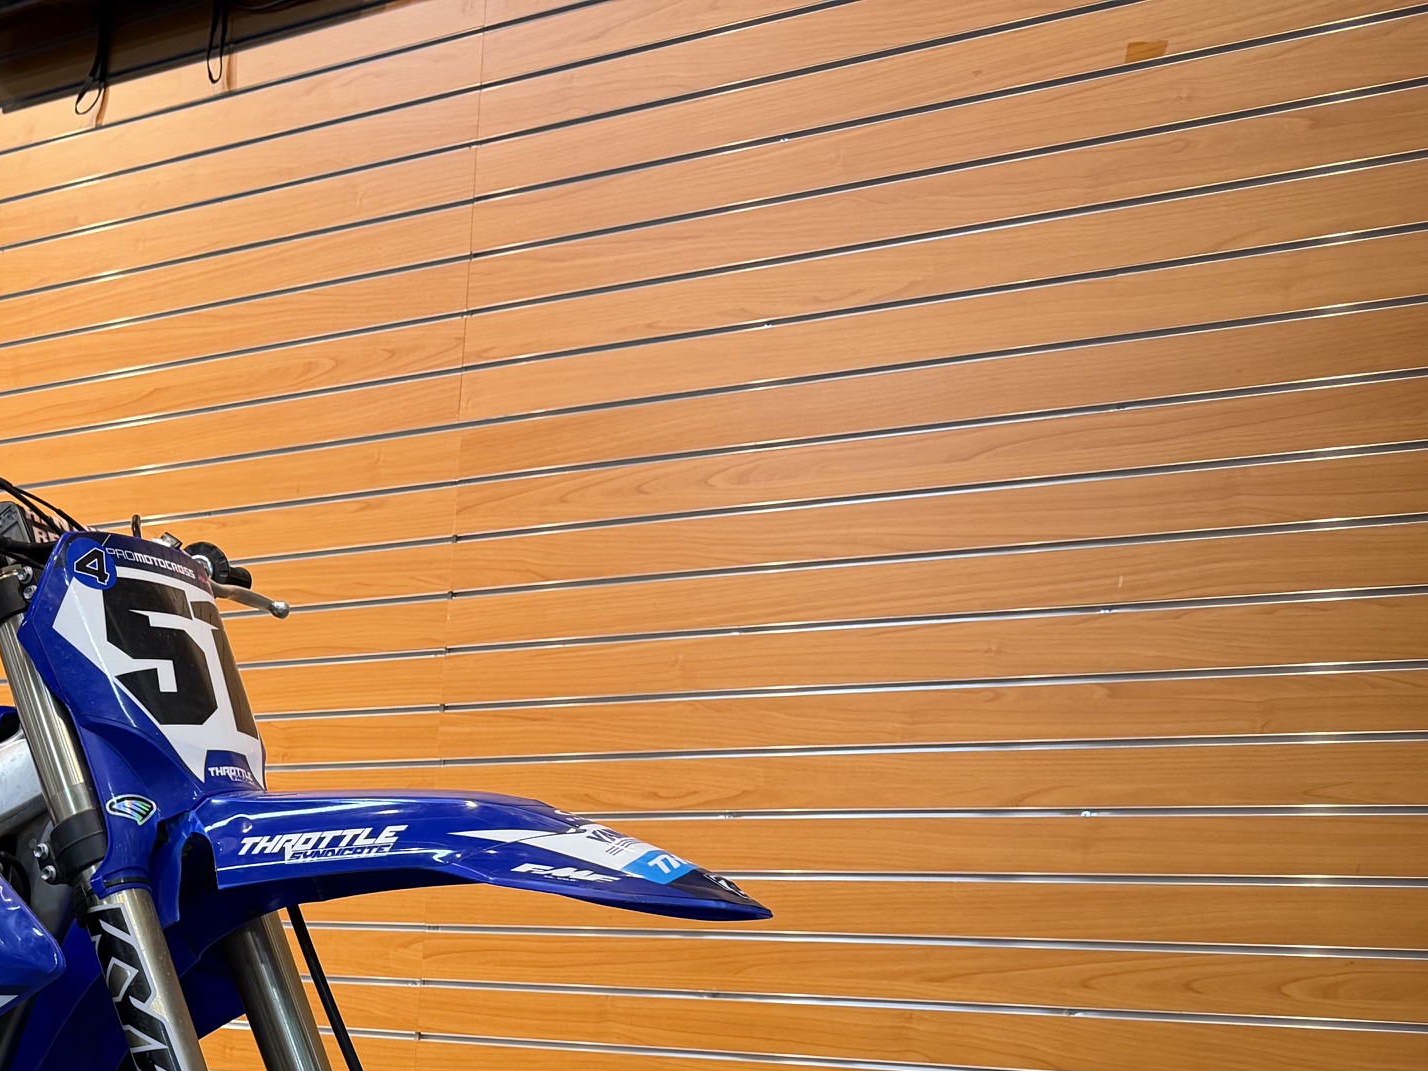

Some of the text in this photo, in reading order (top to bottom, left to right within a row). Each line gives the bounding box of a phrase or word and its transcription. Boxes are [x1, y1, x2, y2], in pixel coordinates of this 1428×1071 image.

[74, 546, 110, 586] 4
[238, 825, 408, 855] THROTTLE
[286, 843, 388, 861] SYNDICATE
[511, 862, 621, 882] FMF
